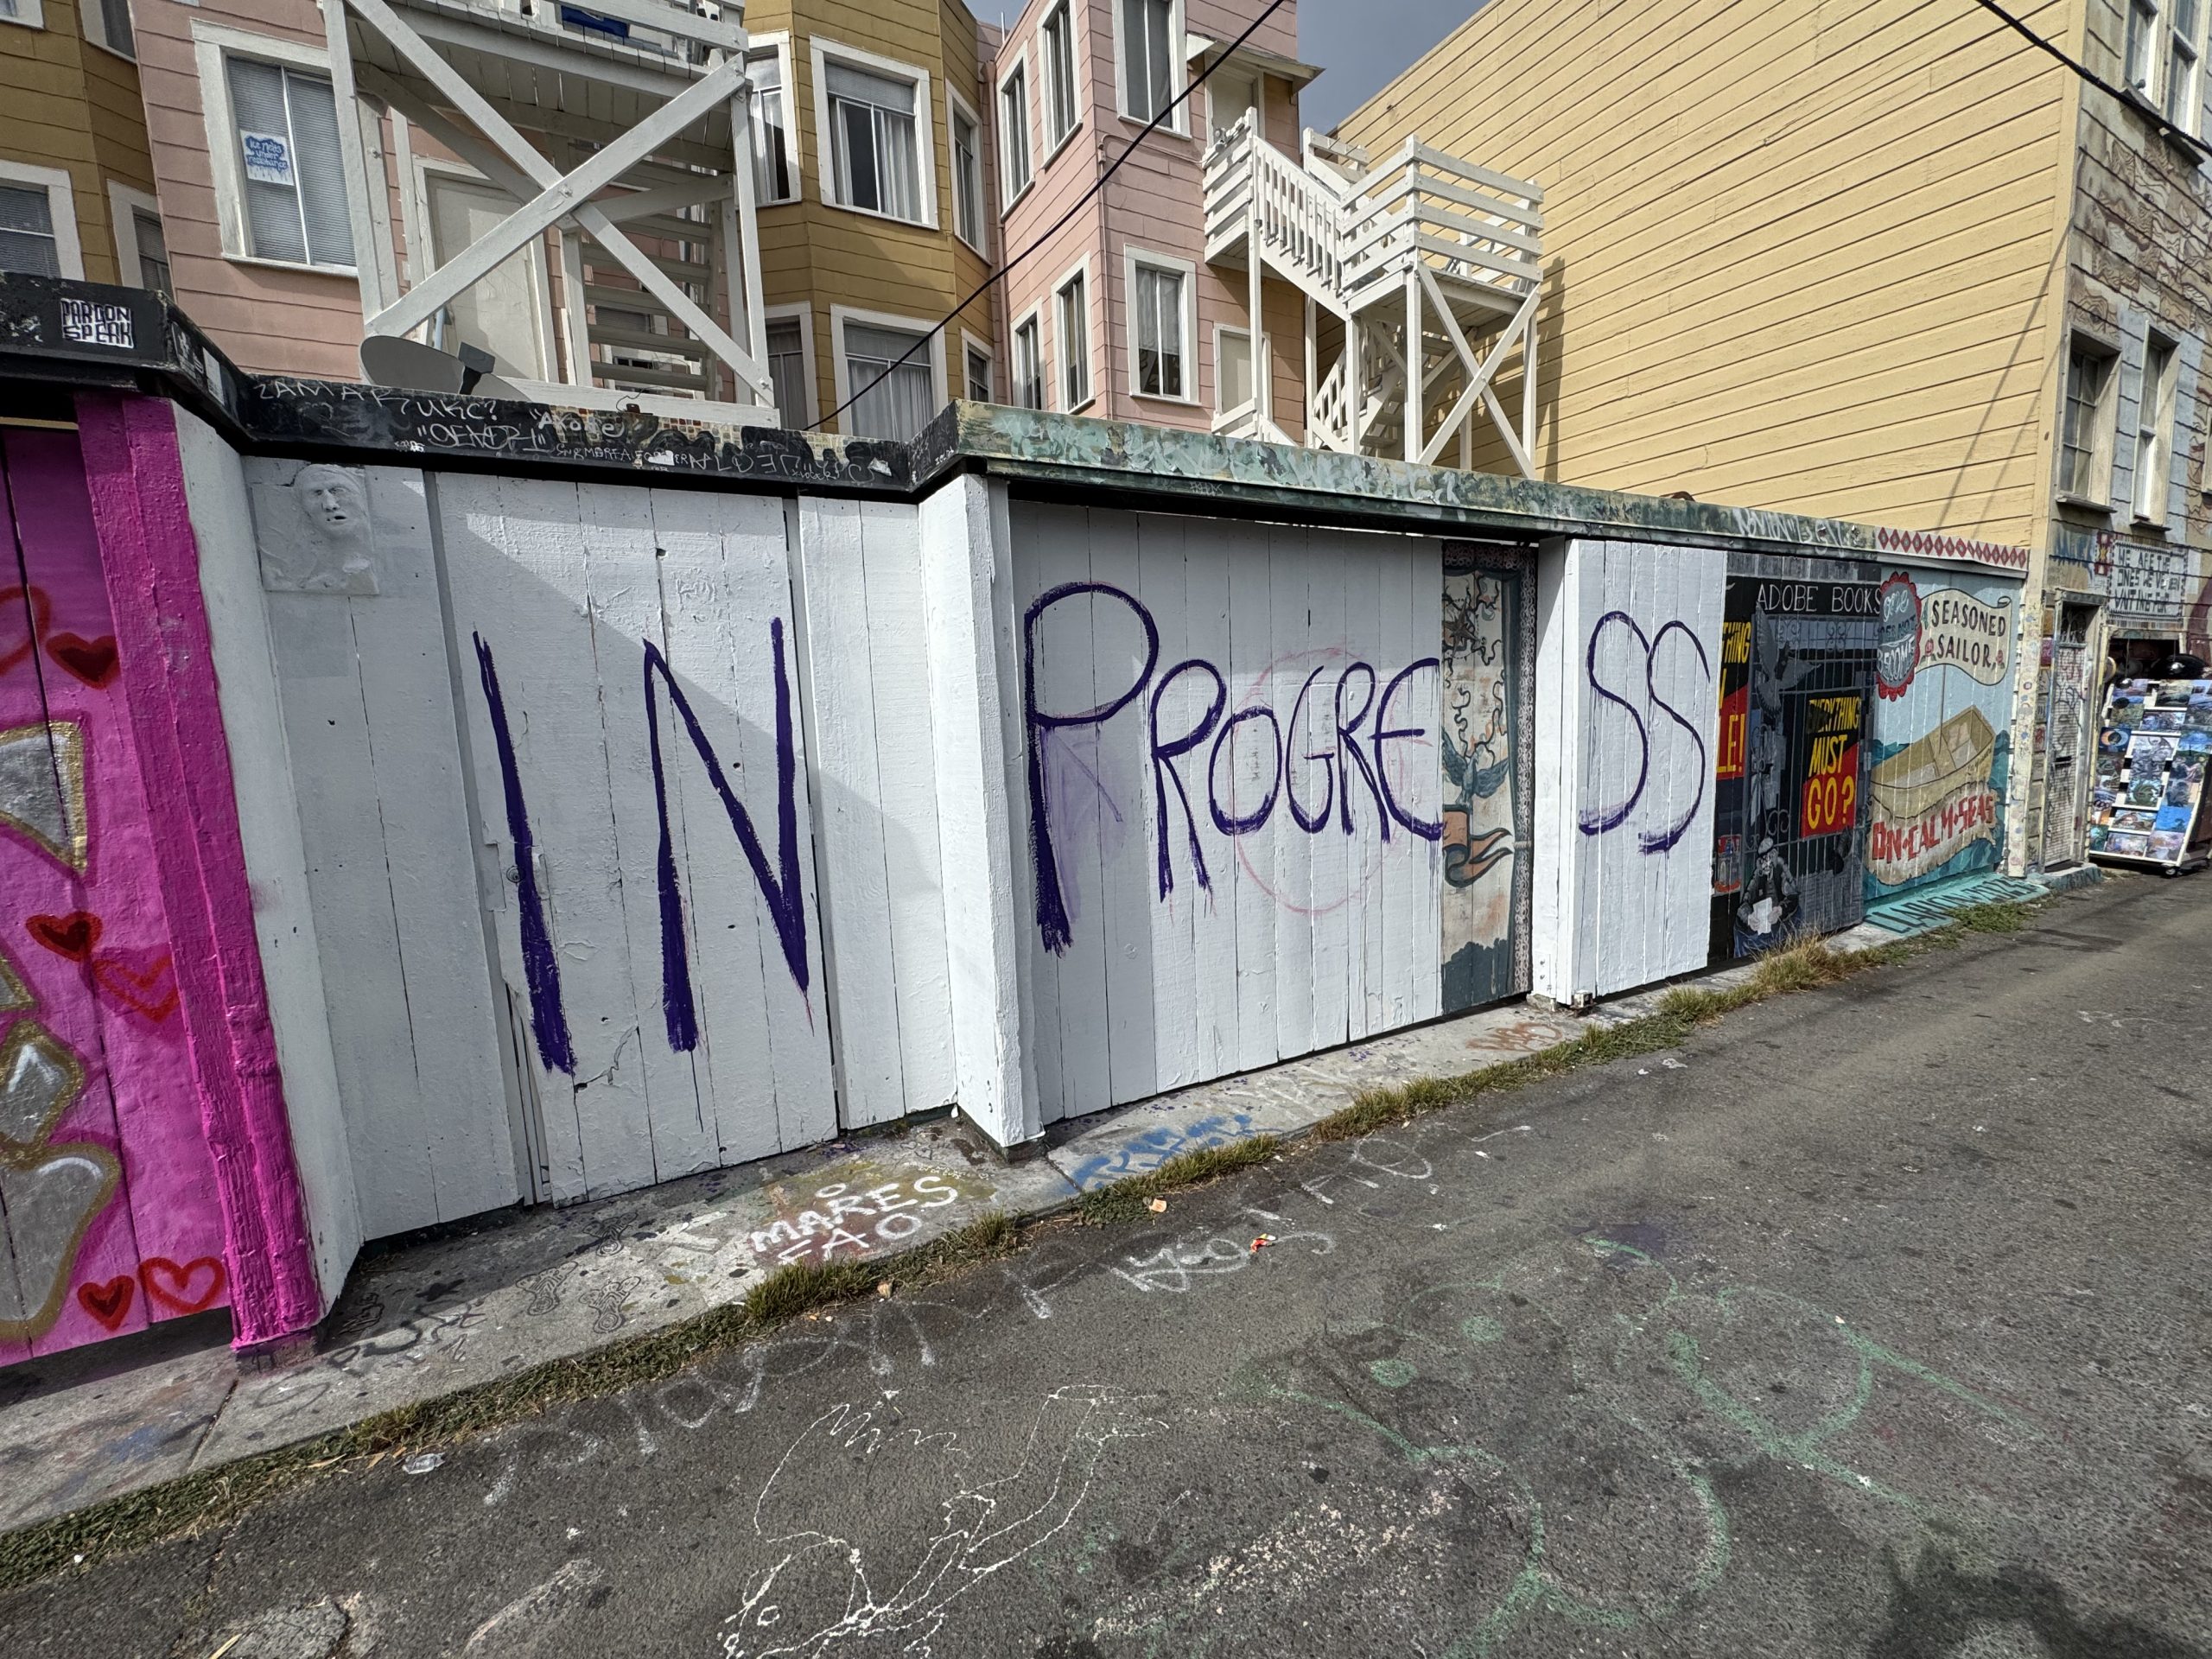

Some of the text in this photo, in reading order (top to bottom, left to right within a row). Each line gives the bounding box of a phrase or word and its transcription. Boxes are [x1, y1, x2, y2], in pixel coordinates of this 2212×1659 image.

[61, 301, 131, 326] PARDON
[1758, 583, 1881, 615] ADOBE BOOKS
[1931, 600, 2006, 637] SEASONED
[1808, 734, 1847, 778] MUST
[1808, 775, 1855, 830] GO?
[472, 617, 815, 1076] IN
